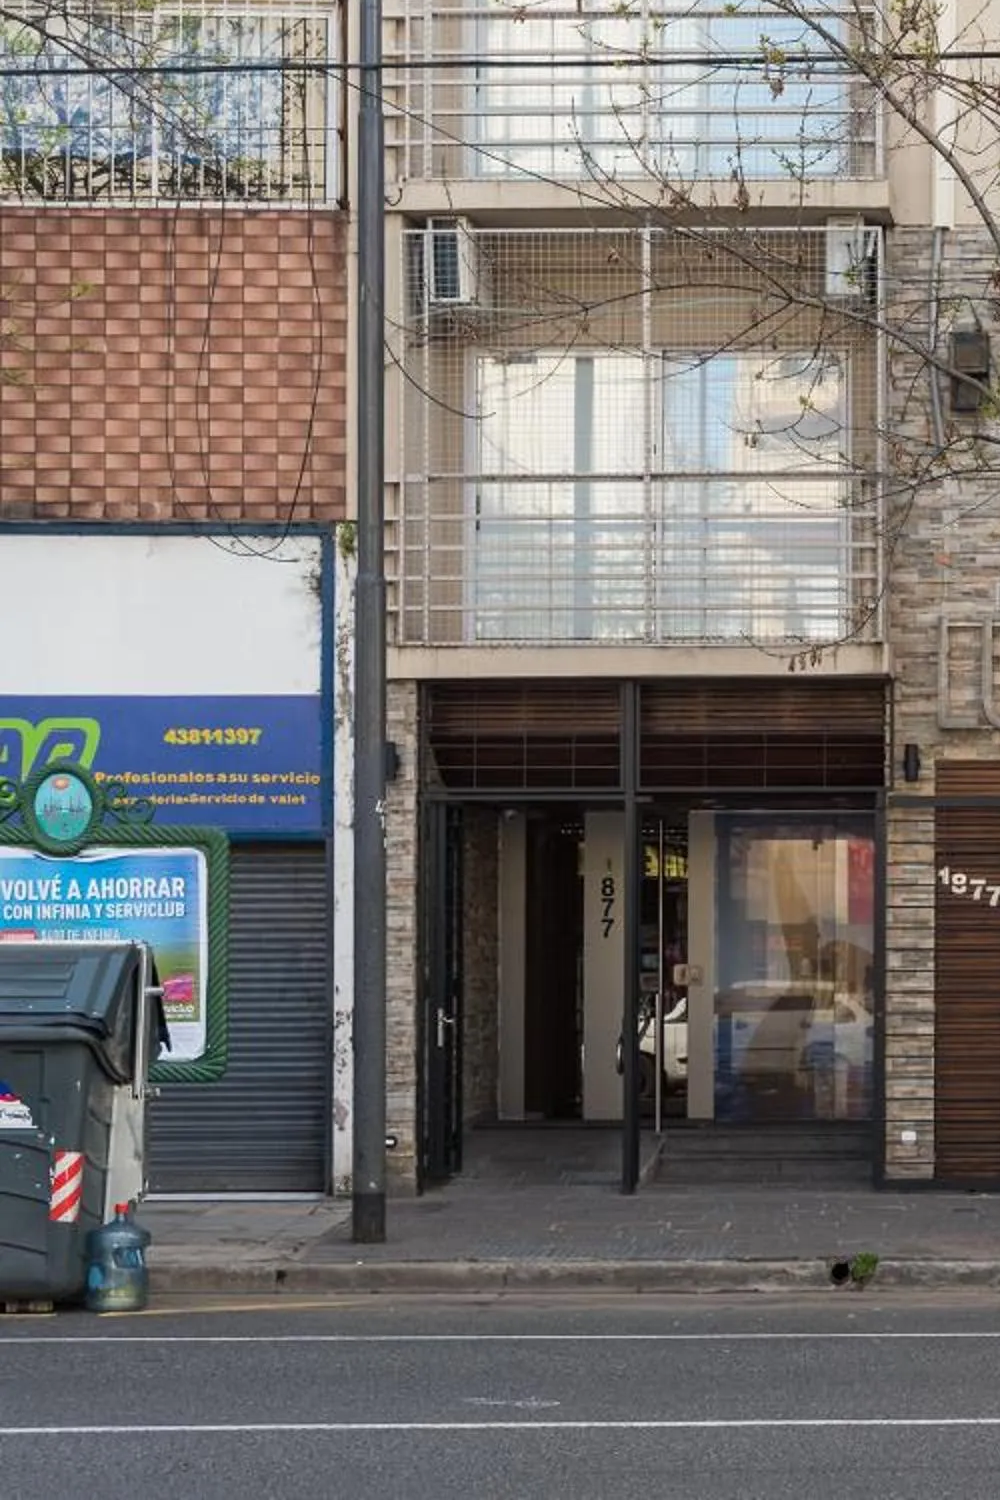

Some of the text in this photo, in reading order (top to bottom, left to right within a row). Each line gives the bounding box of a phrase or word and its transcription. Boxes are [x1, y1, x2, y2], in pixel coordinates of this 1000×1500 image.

[251, 771, 321, 786] servicio
[1, 874, 186, 901] VOLVÉ A AHORRAR
[3, 902, 186, 921] CON INFINIA Y SERVICLUB
